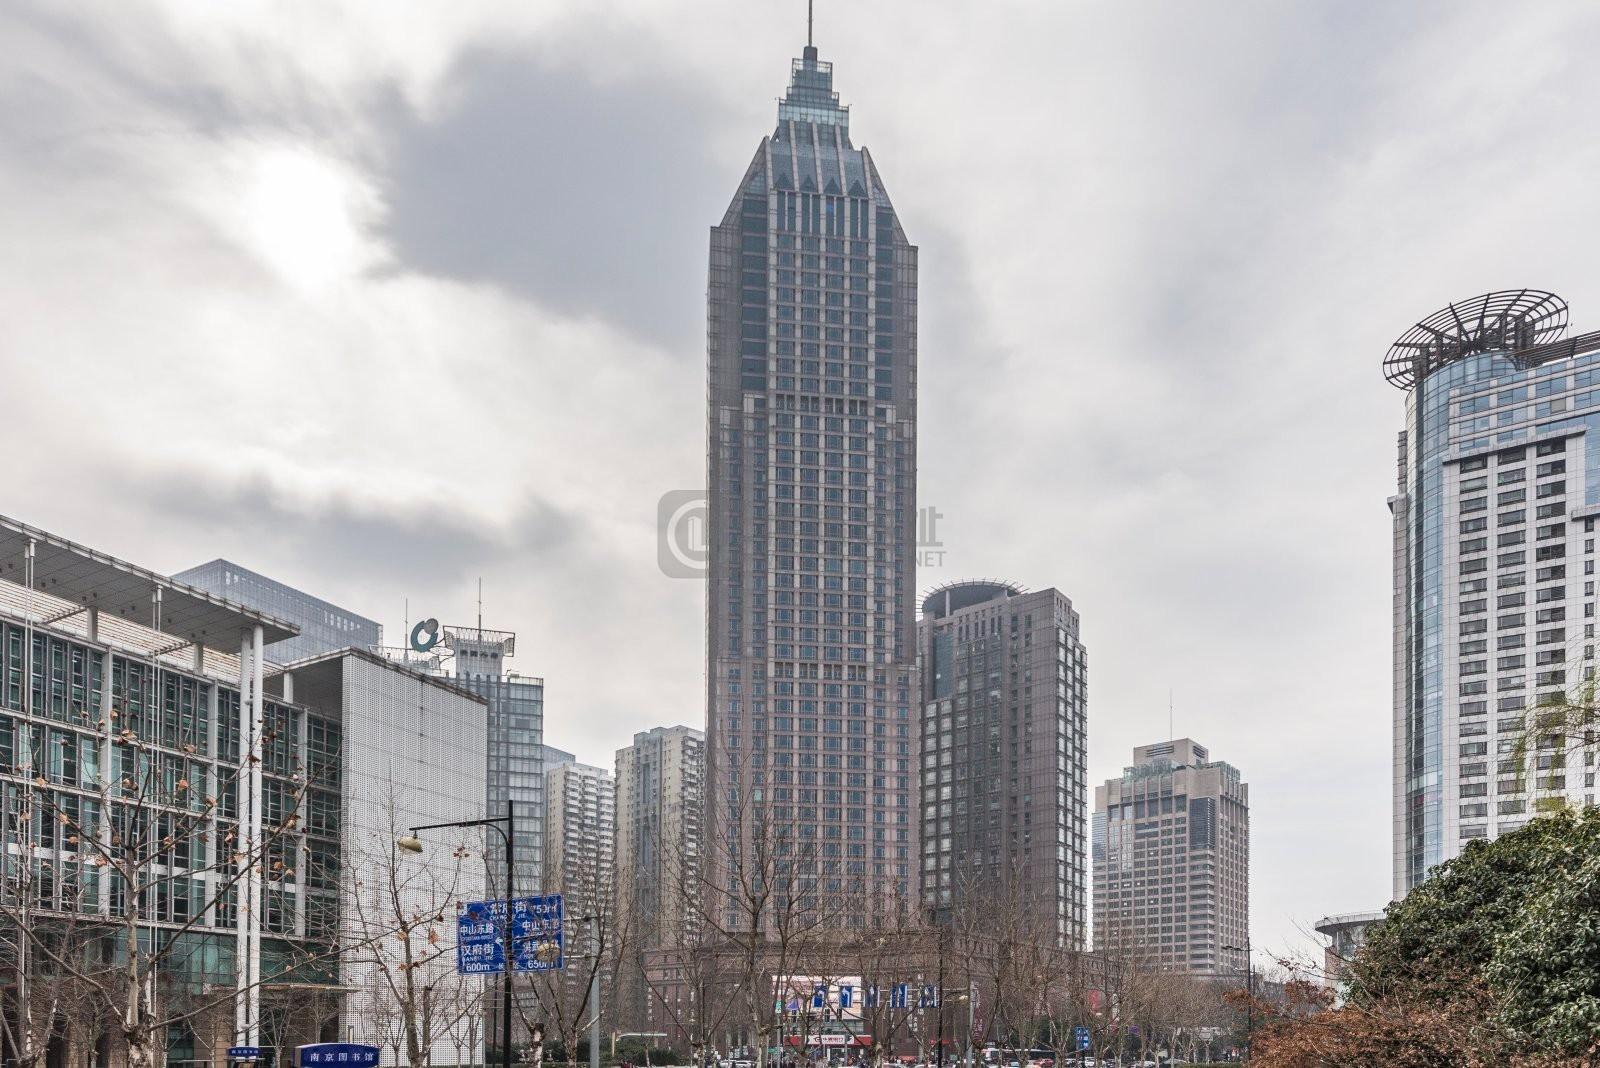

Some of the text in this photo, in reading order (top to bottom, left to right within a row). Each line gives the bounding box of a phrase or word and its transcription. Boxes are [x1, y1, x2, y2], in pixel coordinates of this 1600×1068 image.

[460, 923, 494, 936] 中山东路
[461, 943, 495, 956] 汉府街
[466, 962, 490, 972] 600m
[310, 1052, 374, 1062] 南京图书馆
